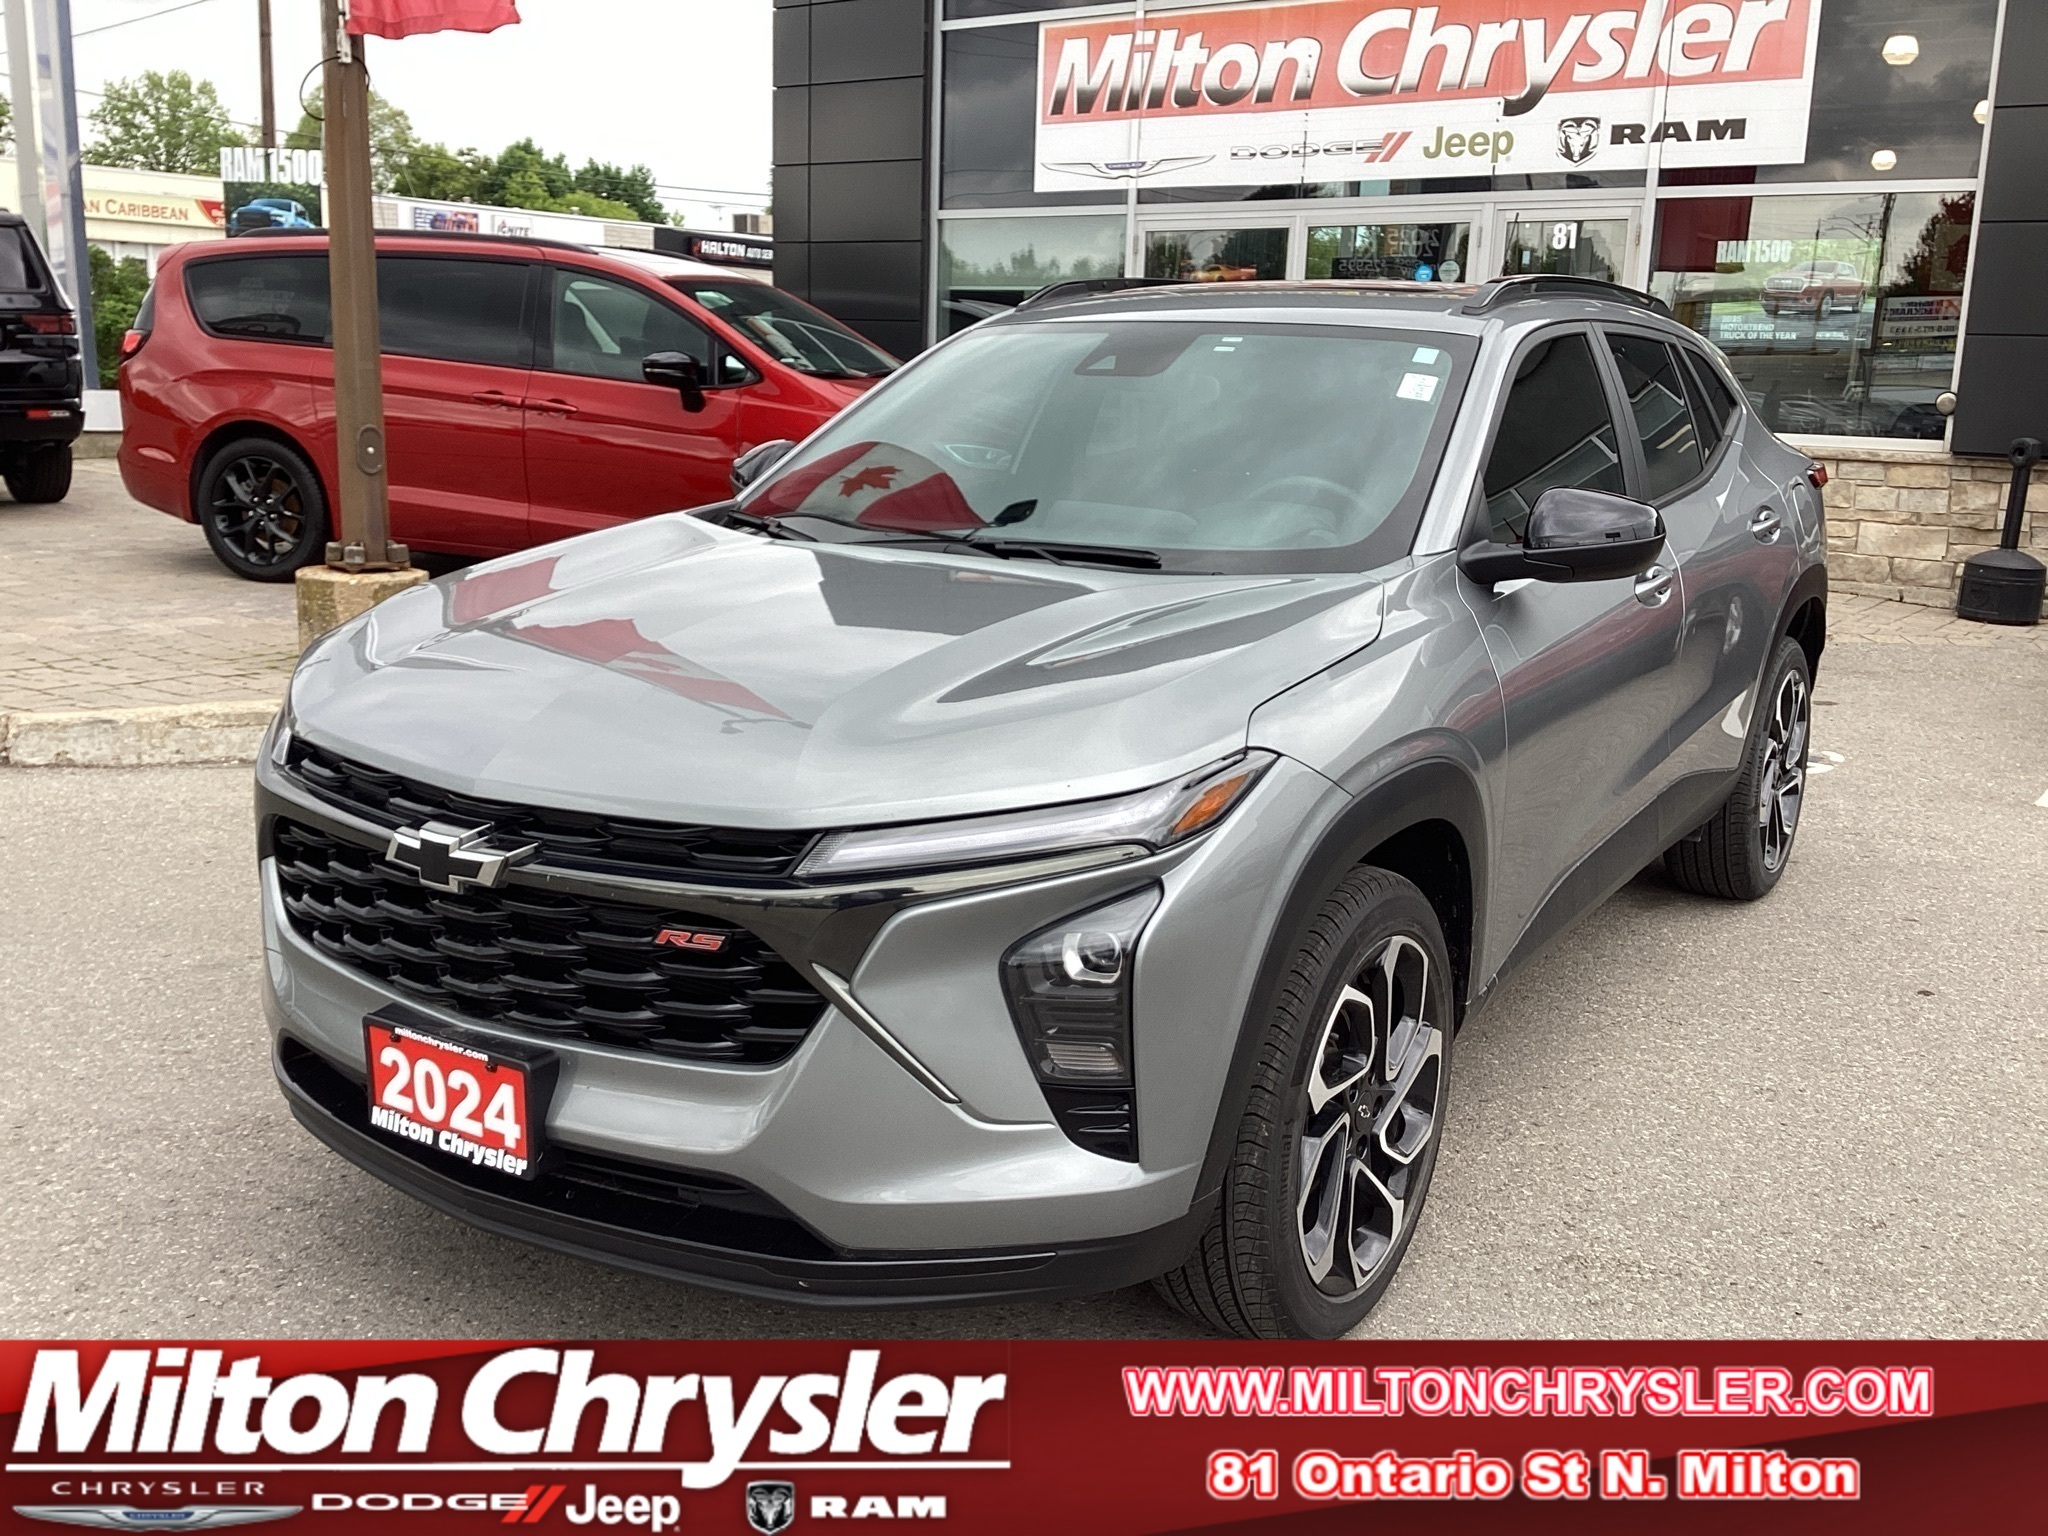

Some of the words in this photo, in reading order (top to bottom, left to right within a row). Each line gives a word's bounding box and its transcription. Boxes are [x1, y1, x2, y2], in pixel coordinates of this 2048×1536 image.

[1049, 29, 1321, 115] Milton
[1336, 0, 1788, 116] Chrysler
[1423, 126, 1514, 163] Jeep
[1610, 118, 1747, 145] RAM
[1230, 139, 1384, 161] DODGE
[219, 147, 265, 183] RAM
[267, 148, 323, 186] 1500
[105, 199, 189, 221] CARIBBEAN
[701, 240, 746, 257] HALTON
[1552, 222, 1577, 250] 81
[1716, 240, 1750, 263] RAM
[1754, 240, 1792, 263] 1500
[1720, 331, 1746, 340] TRUCK
[1748, 331, 1757, 340] OF
[1760, 331, 1774, 340] THE
[1775, 331, 1797, 340] YEAR
[655, 929, 726, 950] RS
[394, 1026, 489, 1062] miltonchrysler.com
[380, 1046, 521, 1149] 2024
[371, 1105, 434, 1145] Milton
[438, 1130, 527, 1176] Chrysler
